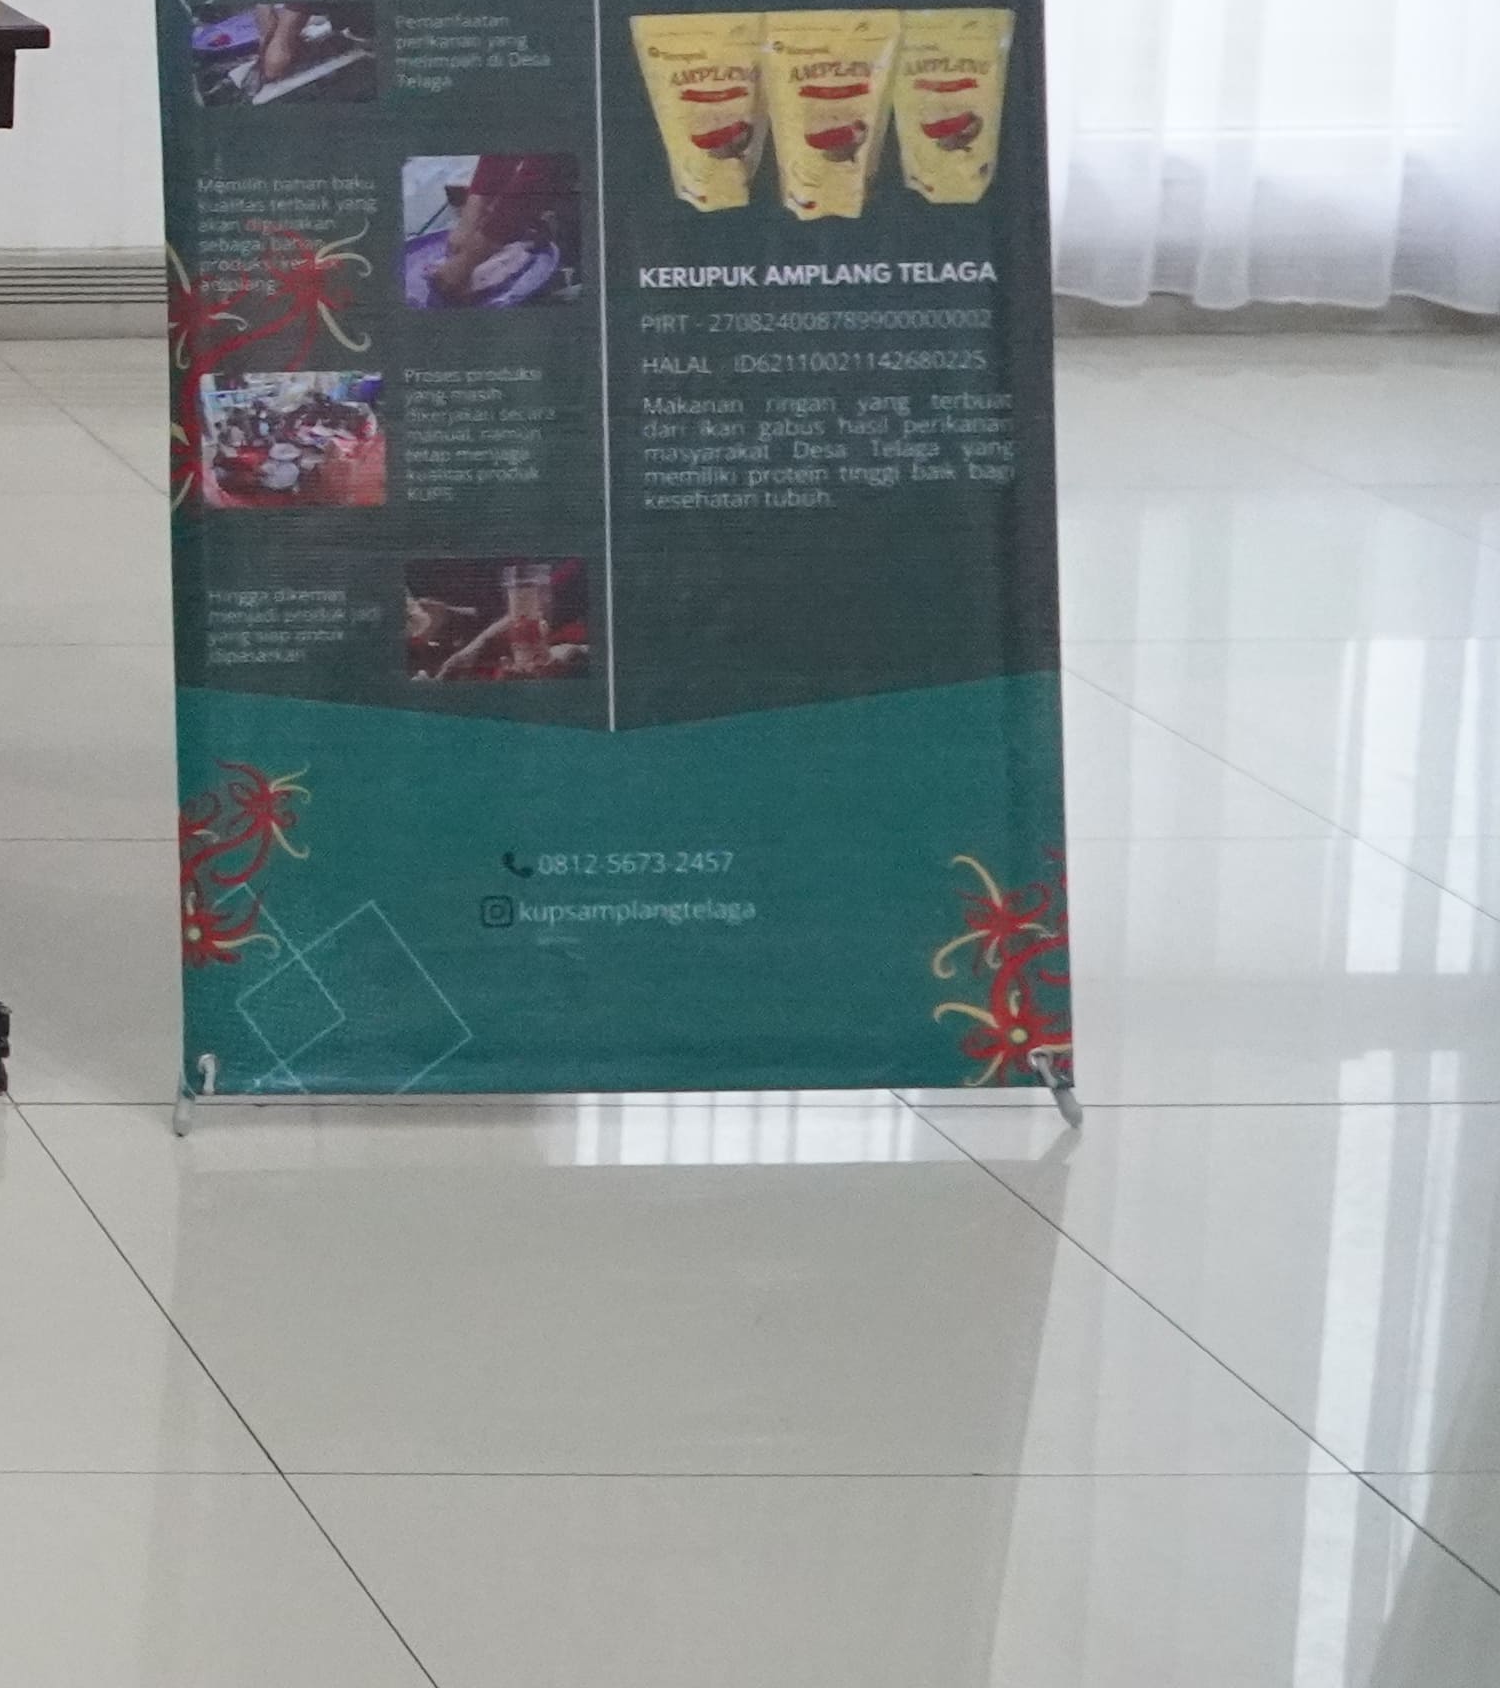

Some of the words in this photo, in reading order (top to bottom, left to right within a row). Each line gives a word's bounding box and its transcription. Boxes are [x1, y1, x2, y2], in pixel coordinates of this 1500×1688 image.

[640, 266, 758, 288] KERUPUK
[764, 263, 892, 286] AMPLANG
[897, 261, 997, 283] TELAGA
[640, 314, 689, 333] PIRT
[642, 356, 711, 374] HALAL
[644, 397, 744, 414] Makanan
[765, 398, 837, 417] ringan
[857, 396, 911, 417] yang
[759, 419, 825, 441] gabus
[838, 418, 888, 434] hasil
[644, 444, 771, 465] masyarakat
[793, 441, 847, 459] Desa
[871, 439, 940, 462] Telaga
[961, 440, 1014, 461] yang
[645, 491, 757, 509] kesehatan
[519, 897, 756, 927] kupsamplangtelaga
